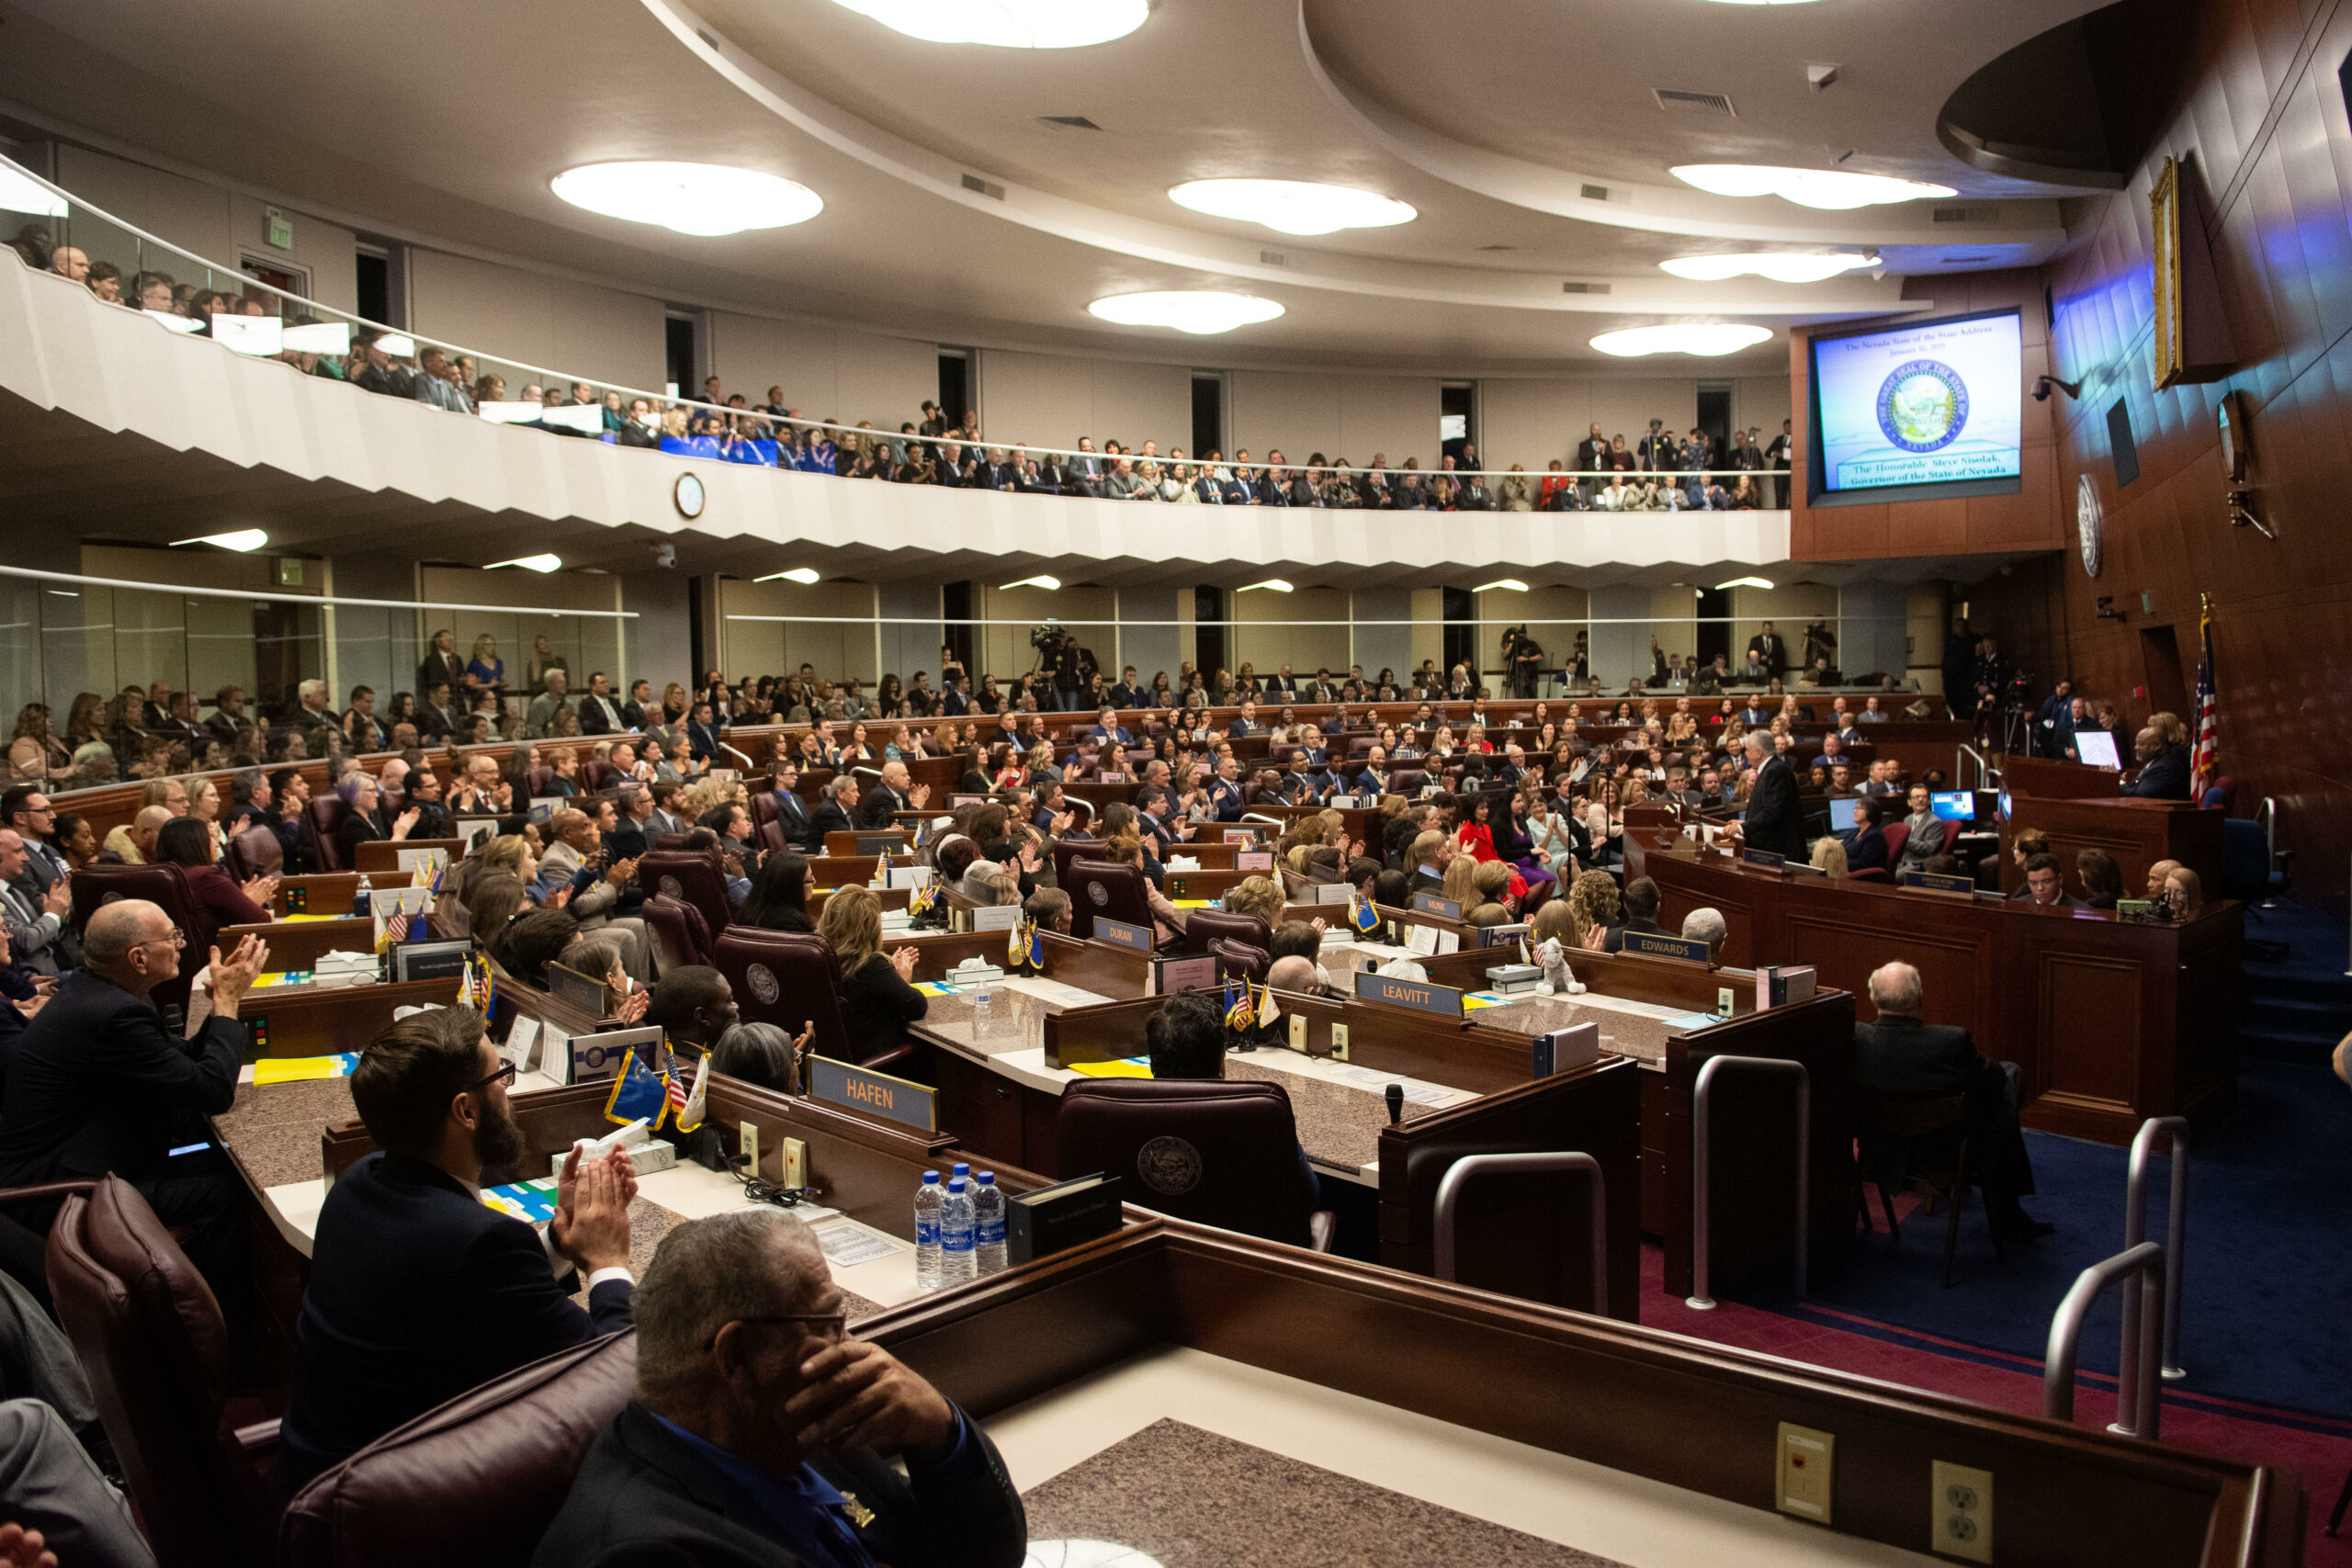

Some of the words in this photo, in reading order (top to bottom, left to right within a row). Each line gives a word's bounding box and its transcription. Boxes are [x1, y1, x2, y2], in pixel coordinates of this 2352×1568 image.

[1846, 344, 1860, 352] The
[1862, 340, 1890, 350] Nevada
[1893, 336, 1911, 345] State
[1913, 334, 1921, 343] of
[1939, 330, 1957, 339] State
[1960, 326, 1992, 337] Address
[1889, 346, 1916, 357] January
[1853, 466, 1871, 474] The
[1876, 462, 1927, 473] Honorable
[1932, 458, 1959, 468] Steve
[1851, 475, 1895, 485] Governor
[1898, 474, 1908, 482] of
[1910, 472, 1927, 481] the
[1929, 470, 1954, 479] State
[1956, 468, 1966, 477] of
[1968, 466, 2006, 475] Nevada
[1428, 900, 1446, 911] MUNK
[1109, 927, 1132, 942] DURAN
[1641, 940, 1689, 956] EDWARDS
[1383, 984, 1430, 1005] LEAVITT
[847, 1078, 893, 1109] HAFEN
[942, 1235, 970, 1245] AQUAFINA
